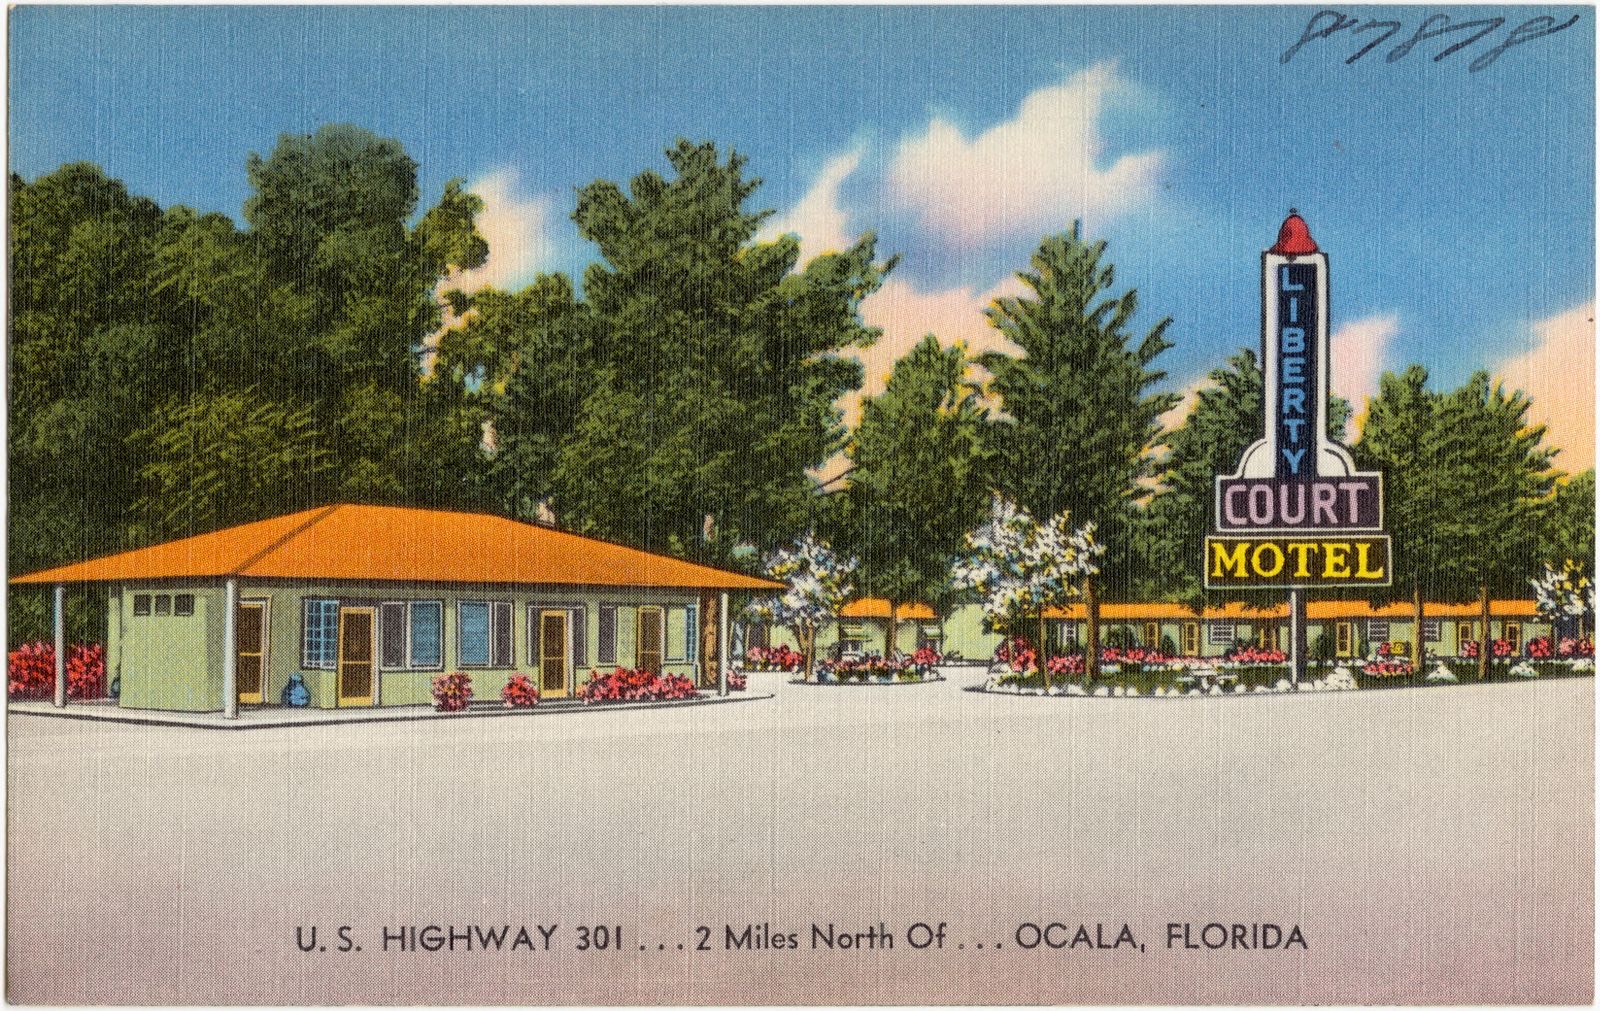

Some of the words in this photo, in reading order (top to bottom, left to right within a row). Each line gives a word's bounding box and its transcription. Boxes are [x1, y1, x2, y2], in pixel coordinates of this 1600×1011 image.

[1281, 266, 1306, 475] LIBERTY
[1224, 482, 1370, 526] COURT
[1210, 542, 1384, 579] MOTEL
